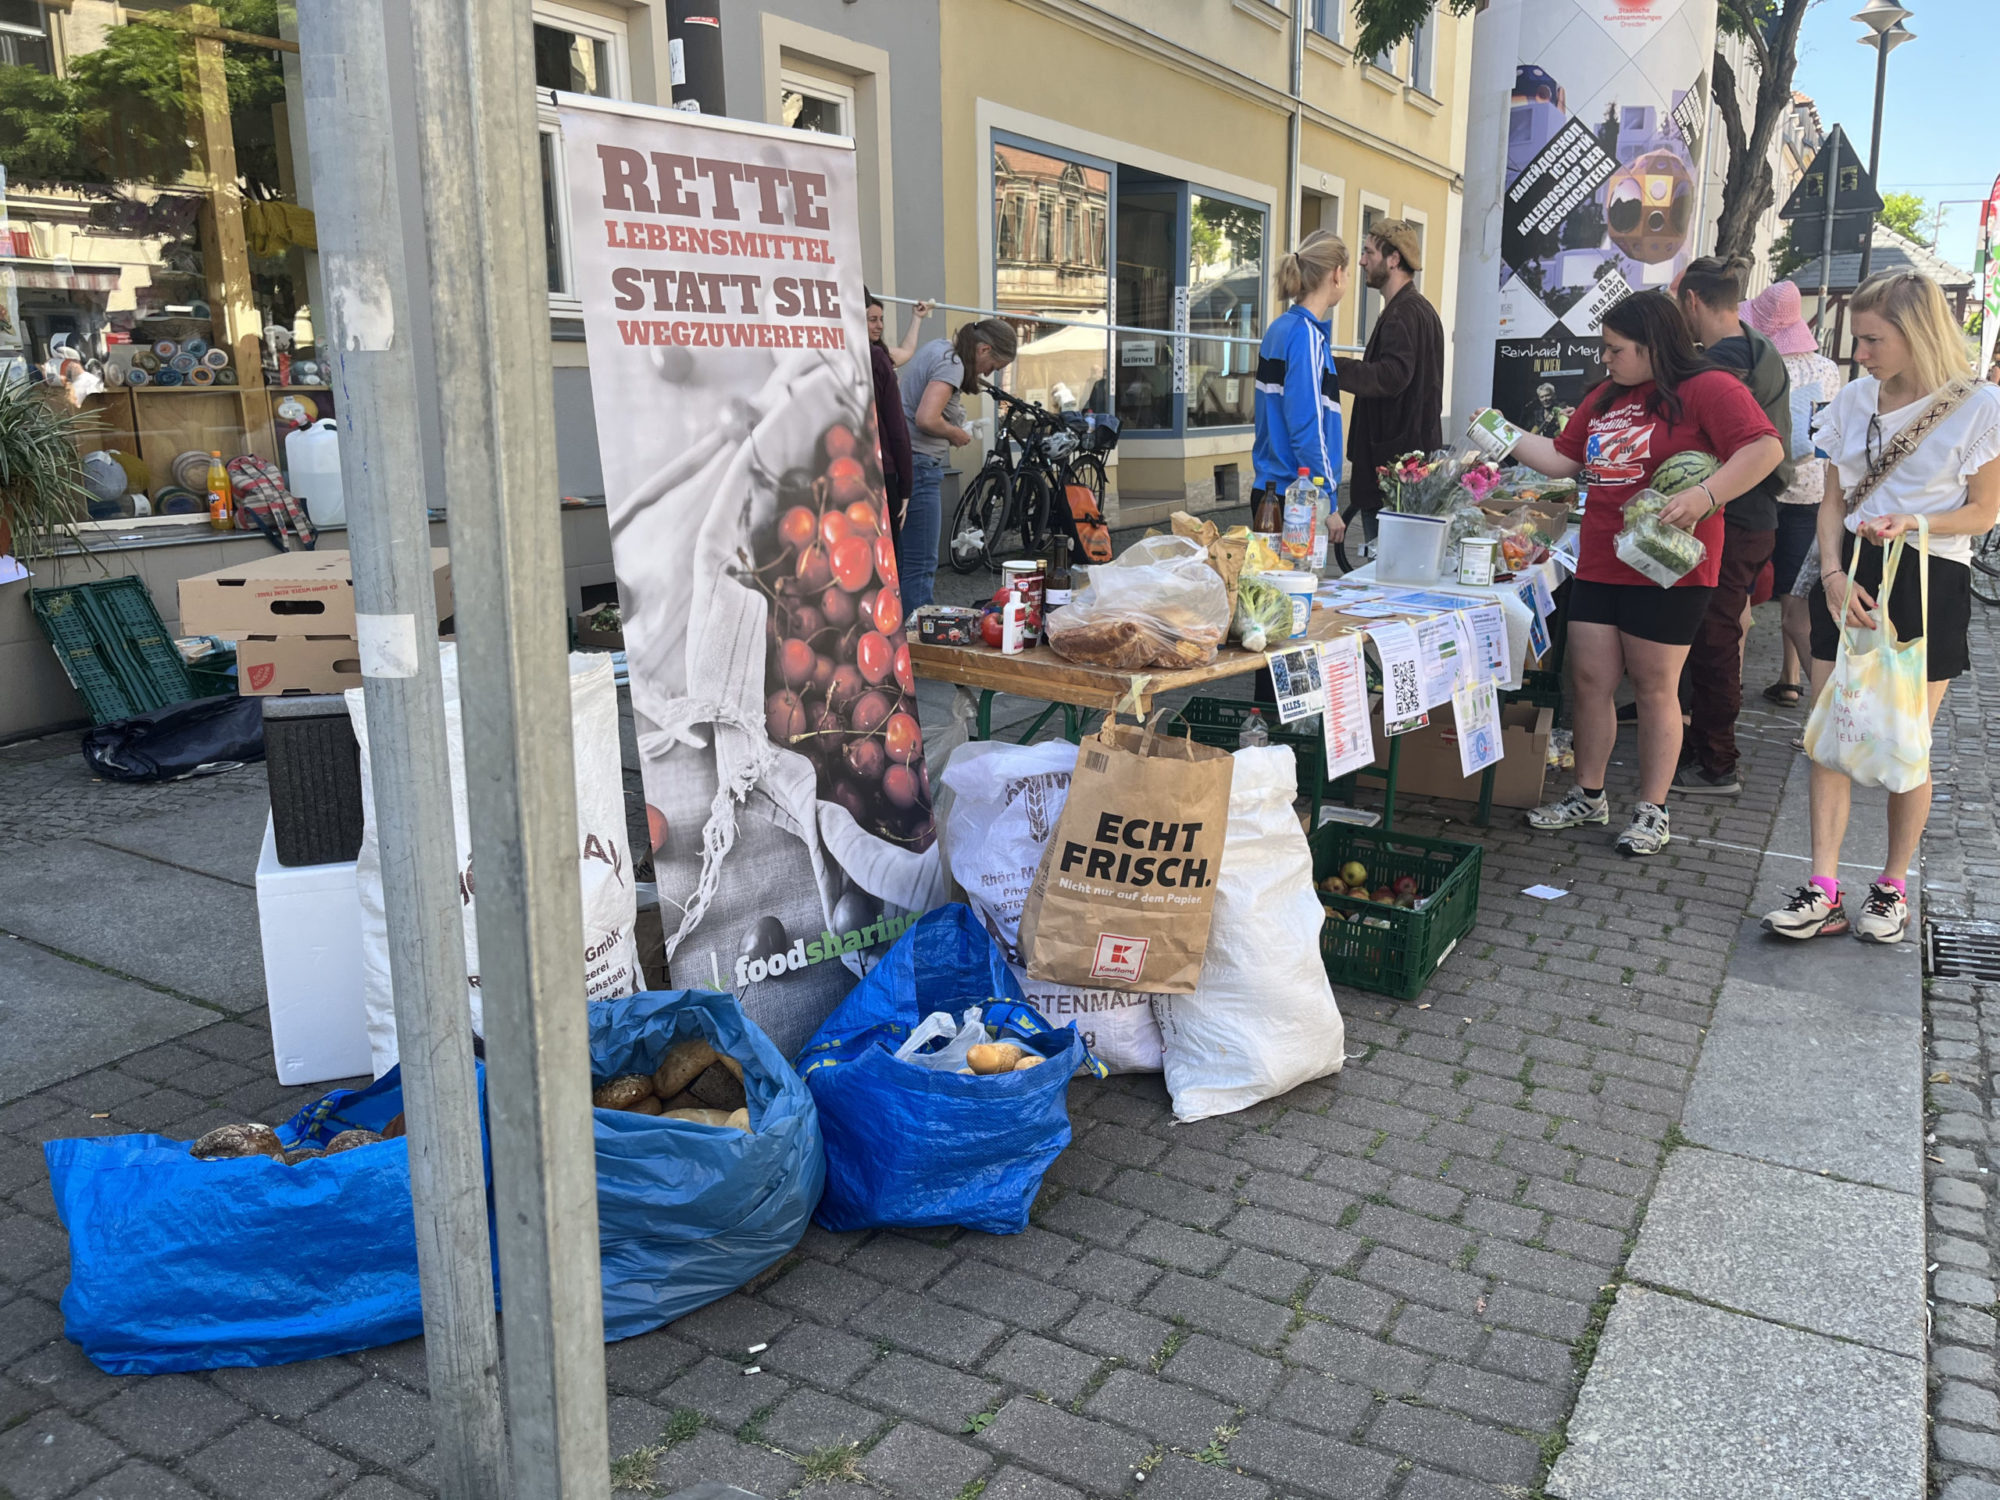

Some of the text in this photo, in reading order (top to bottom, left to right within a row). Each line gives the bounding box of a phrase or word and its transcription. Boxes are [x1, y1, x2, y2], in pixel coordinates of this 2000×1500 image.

[1509, 122, 1584, 203] КАЛЕЙДОСКОП
[1548, 133, 1595, 180] ІСТОРІЙ
[596, 143, 830, 231] RETTE
[1517, 145, 1606, 237] KALEIDOSKOP DER
[1537, 156, 1616, 235] GESCHICHTE(N)
[604, 219, 836, 264] LEBENSMITTEL
[611, 267, 842, 319] STATT SIE
[1588, 279, 1625, 316] 10.9.2023
[616, 319, 846, 350] WEGZUWERFEN!
[1500, 342, 1600, 365] Reinhard Mey
[1543, 358, 1561, 372] WIEN
[1282, 699, 1301, 713] ALLES
[1095, 811, 1203, 852] ECHT
[1059, 840, 1212, 889] FRISCH.
[1058, 876, 1202, 905] Nicht nur auf dem Papier.
[1099, 965, 1136, 975] Kaufland
